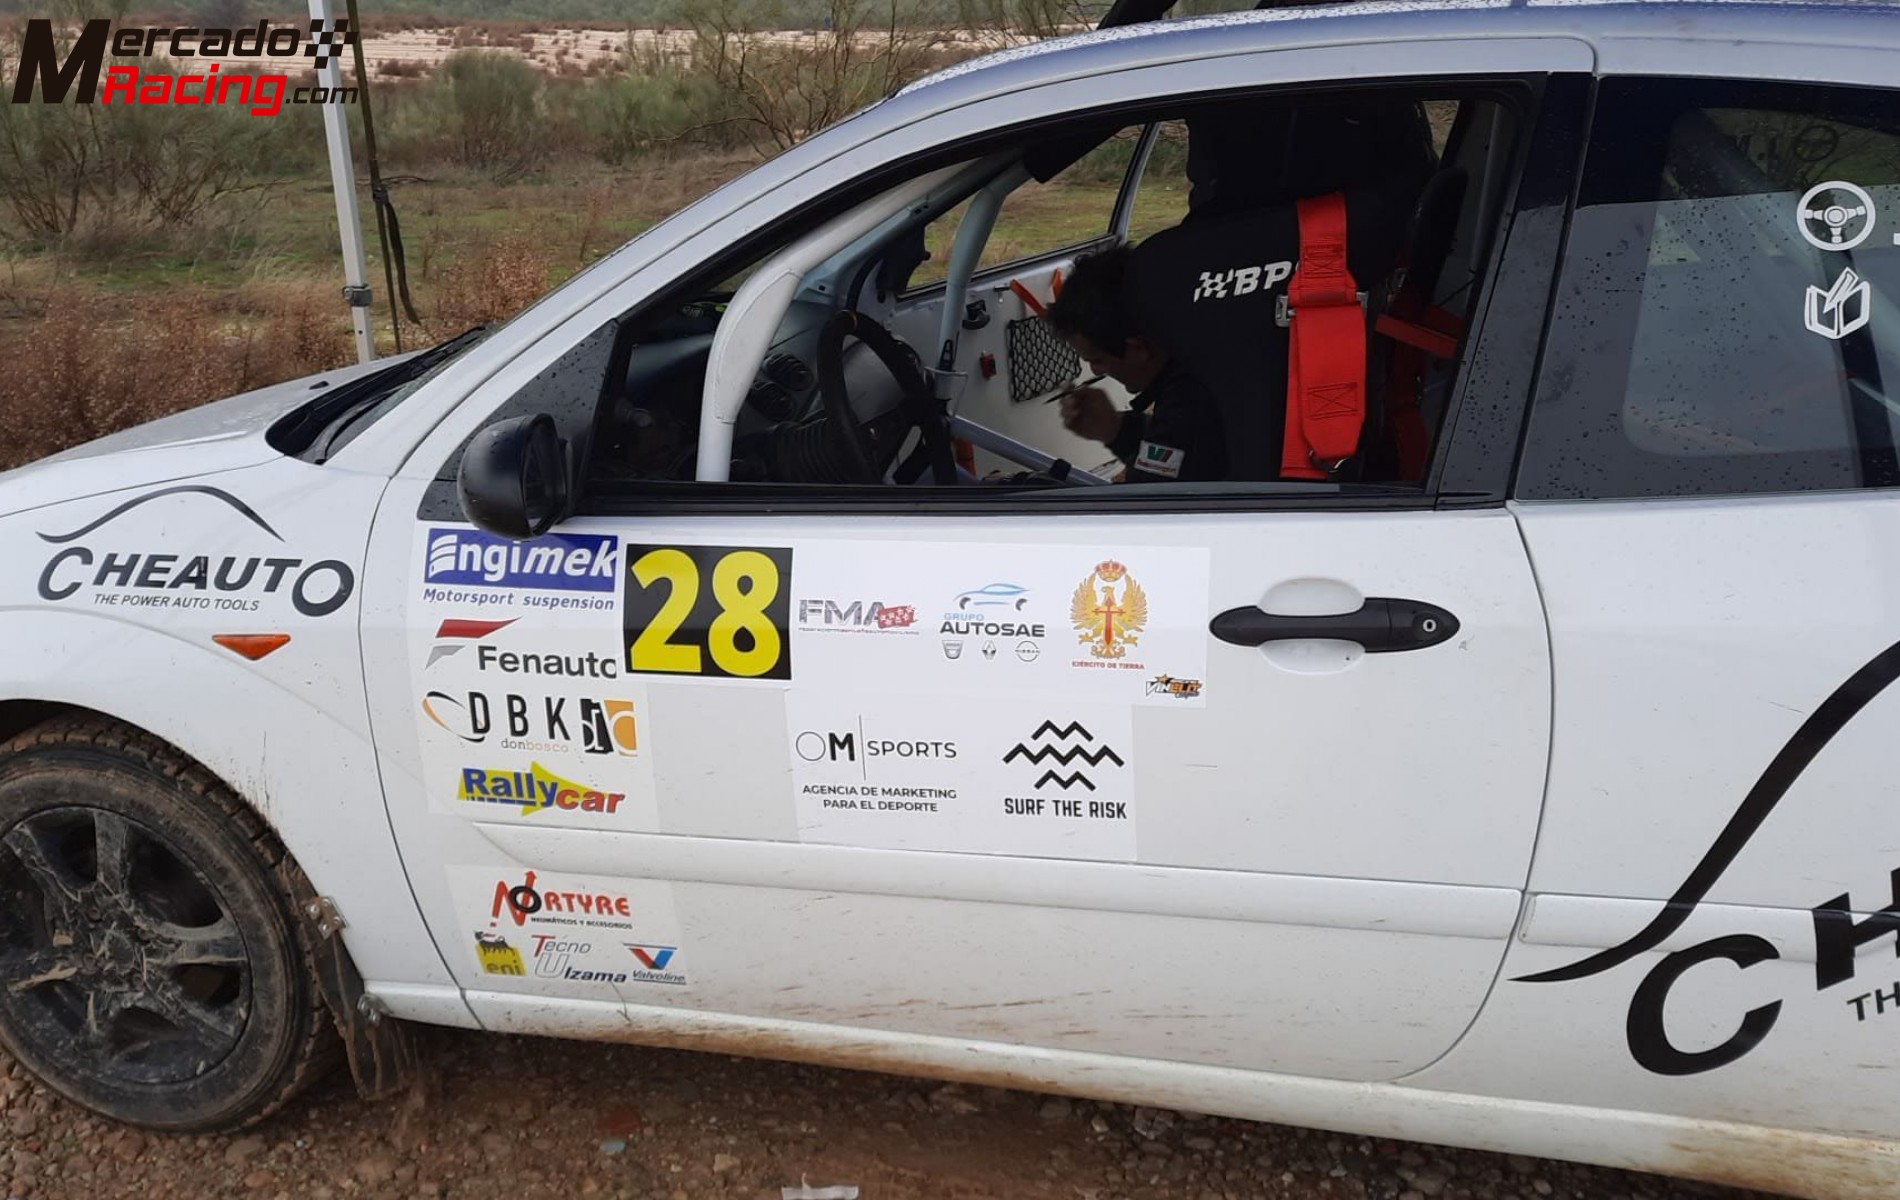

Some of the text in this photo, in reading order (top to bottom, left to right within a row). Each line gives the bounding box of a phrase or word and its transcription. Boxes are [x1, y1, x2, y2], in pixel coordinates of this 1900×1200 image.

[37, 546, 354, 617] CHEAUTO
[94, 593, 260, 611] THE POWER AUTO TOOLS
[423, 588, 614, 610] Motorsport suspension
[630, 548, 781, 677] 28
[944, 612, 985, 621] GRUPO
[940, 621, 1045, 637] AUTOSAE
[500, 738, 569, 752] donbosco
[867, 740, 957, 758] SPORTS
[463, 767, 626, 814] Rallycar
[803, 785, 957, 799] AGENCIA DE MARKETING
[823, 799, 938, 812] PARA EL DEPORTE
[1004, 798, 1127, 819] SURF THE RISK
[532, 935, 591, 957] Tecno
[632, 970, 686, 982] Valvoline
